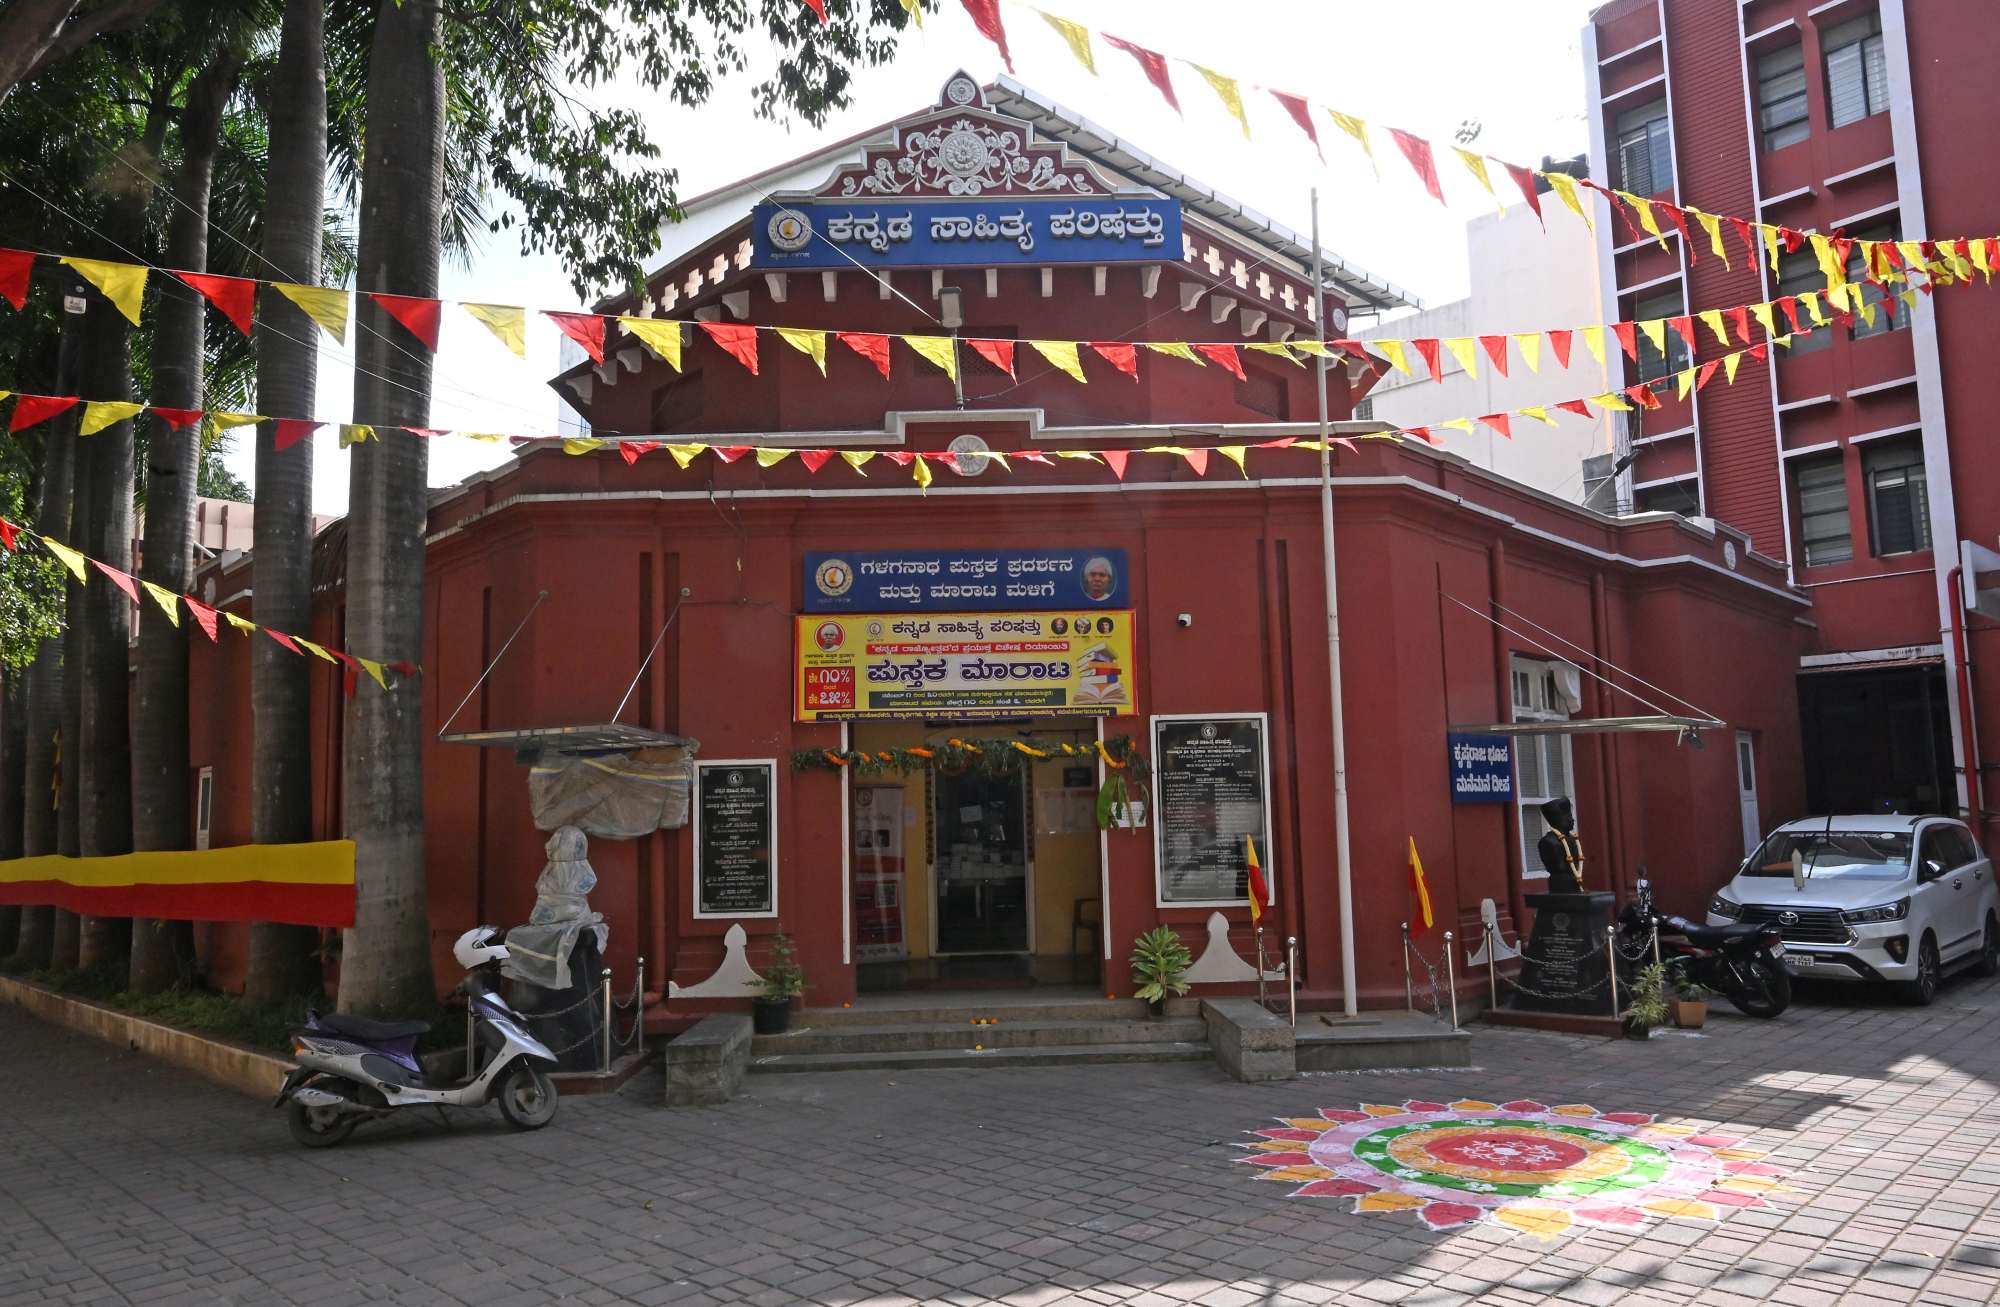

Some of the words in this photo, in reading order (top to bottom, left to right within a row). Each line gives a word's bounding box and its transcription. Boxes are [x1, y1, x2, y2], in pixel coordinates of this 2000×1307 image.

[827, 208, 914, 256] ಕನ್ನಡ
[930, 206, 1034, 255] ಸಾಹಿತ್ಯ
[1049, 206, 1165, 247] ಪರಿಷತ್ತು
[860, 559, 940, 576] ಗಳಗನಾಥ
[949, 557, 998, 578] ಪುಸ್ತಕ
[1007, 557, 1073, 577] ಪ್ರದರ್ಶನ
[879, 584, 922, 603] ಮತ್ತು
[930, 583, 997, 599] ಮಾರಾಟ
[1006, 580, 1056, 597] ಮಳಿಗೆ
[891, 620, 931, 640] ಕನ್ನಡ
[937, 618, 984, 640] ಸಾಹಿತ್ಯ
[990, 617, 1041, 636] ಪರಿಷತ್ತು
[867, 658, 947, 688] ಪುಸ್ತಕ
[961, 657, 1071, 681] ಮಾರಾಟ
[1454, 743, 1487, 769] ಕೃಷ್ಣರಾಜ
[1456, 773, 1490, 793] ಮನೆಮನೆ
[1491, 774, 1510, 792] ದೀಪ
